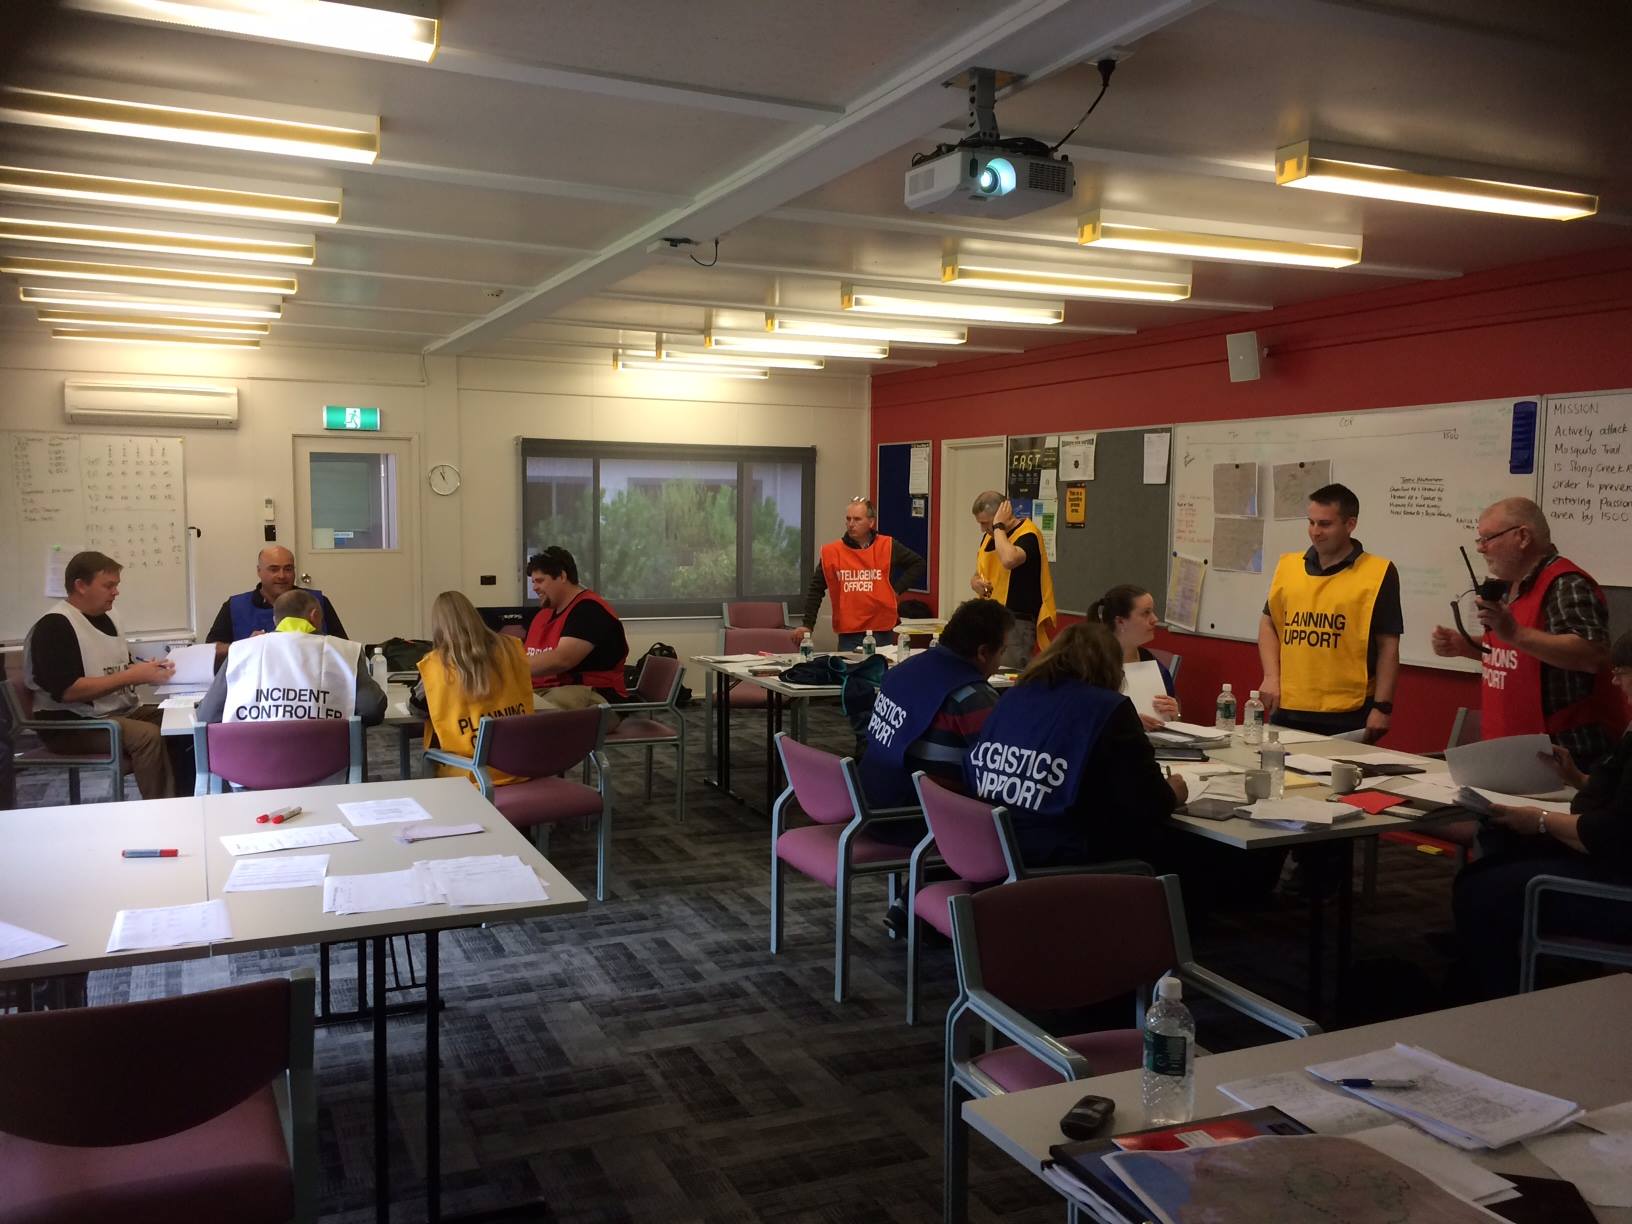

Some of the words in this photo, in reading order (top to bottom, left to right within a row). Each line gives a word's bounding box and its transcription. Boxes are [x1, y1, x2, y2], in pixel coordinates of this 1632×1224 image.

[1553, 403, 1599, 415] MISSION
[1554, 425, 1593, 442] Actively
[1554, 443, 1597, 457] Mosquito
[1013, 454, 1040, 470] FAST
[843, 581, 873, 592] OFFICER
[255, 688, 330, 704] INCIDENT
